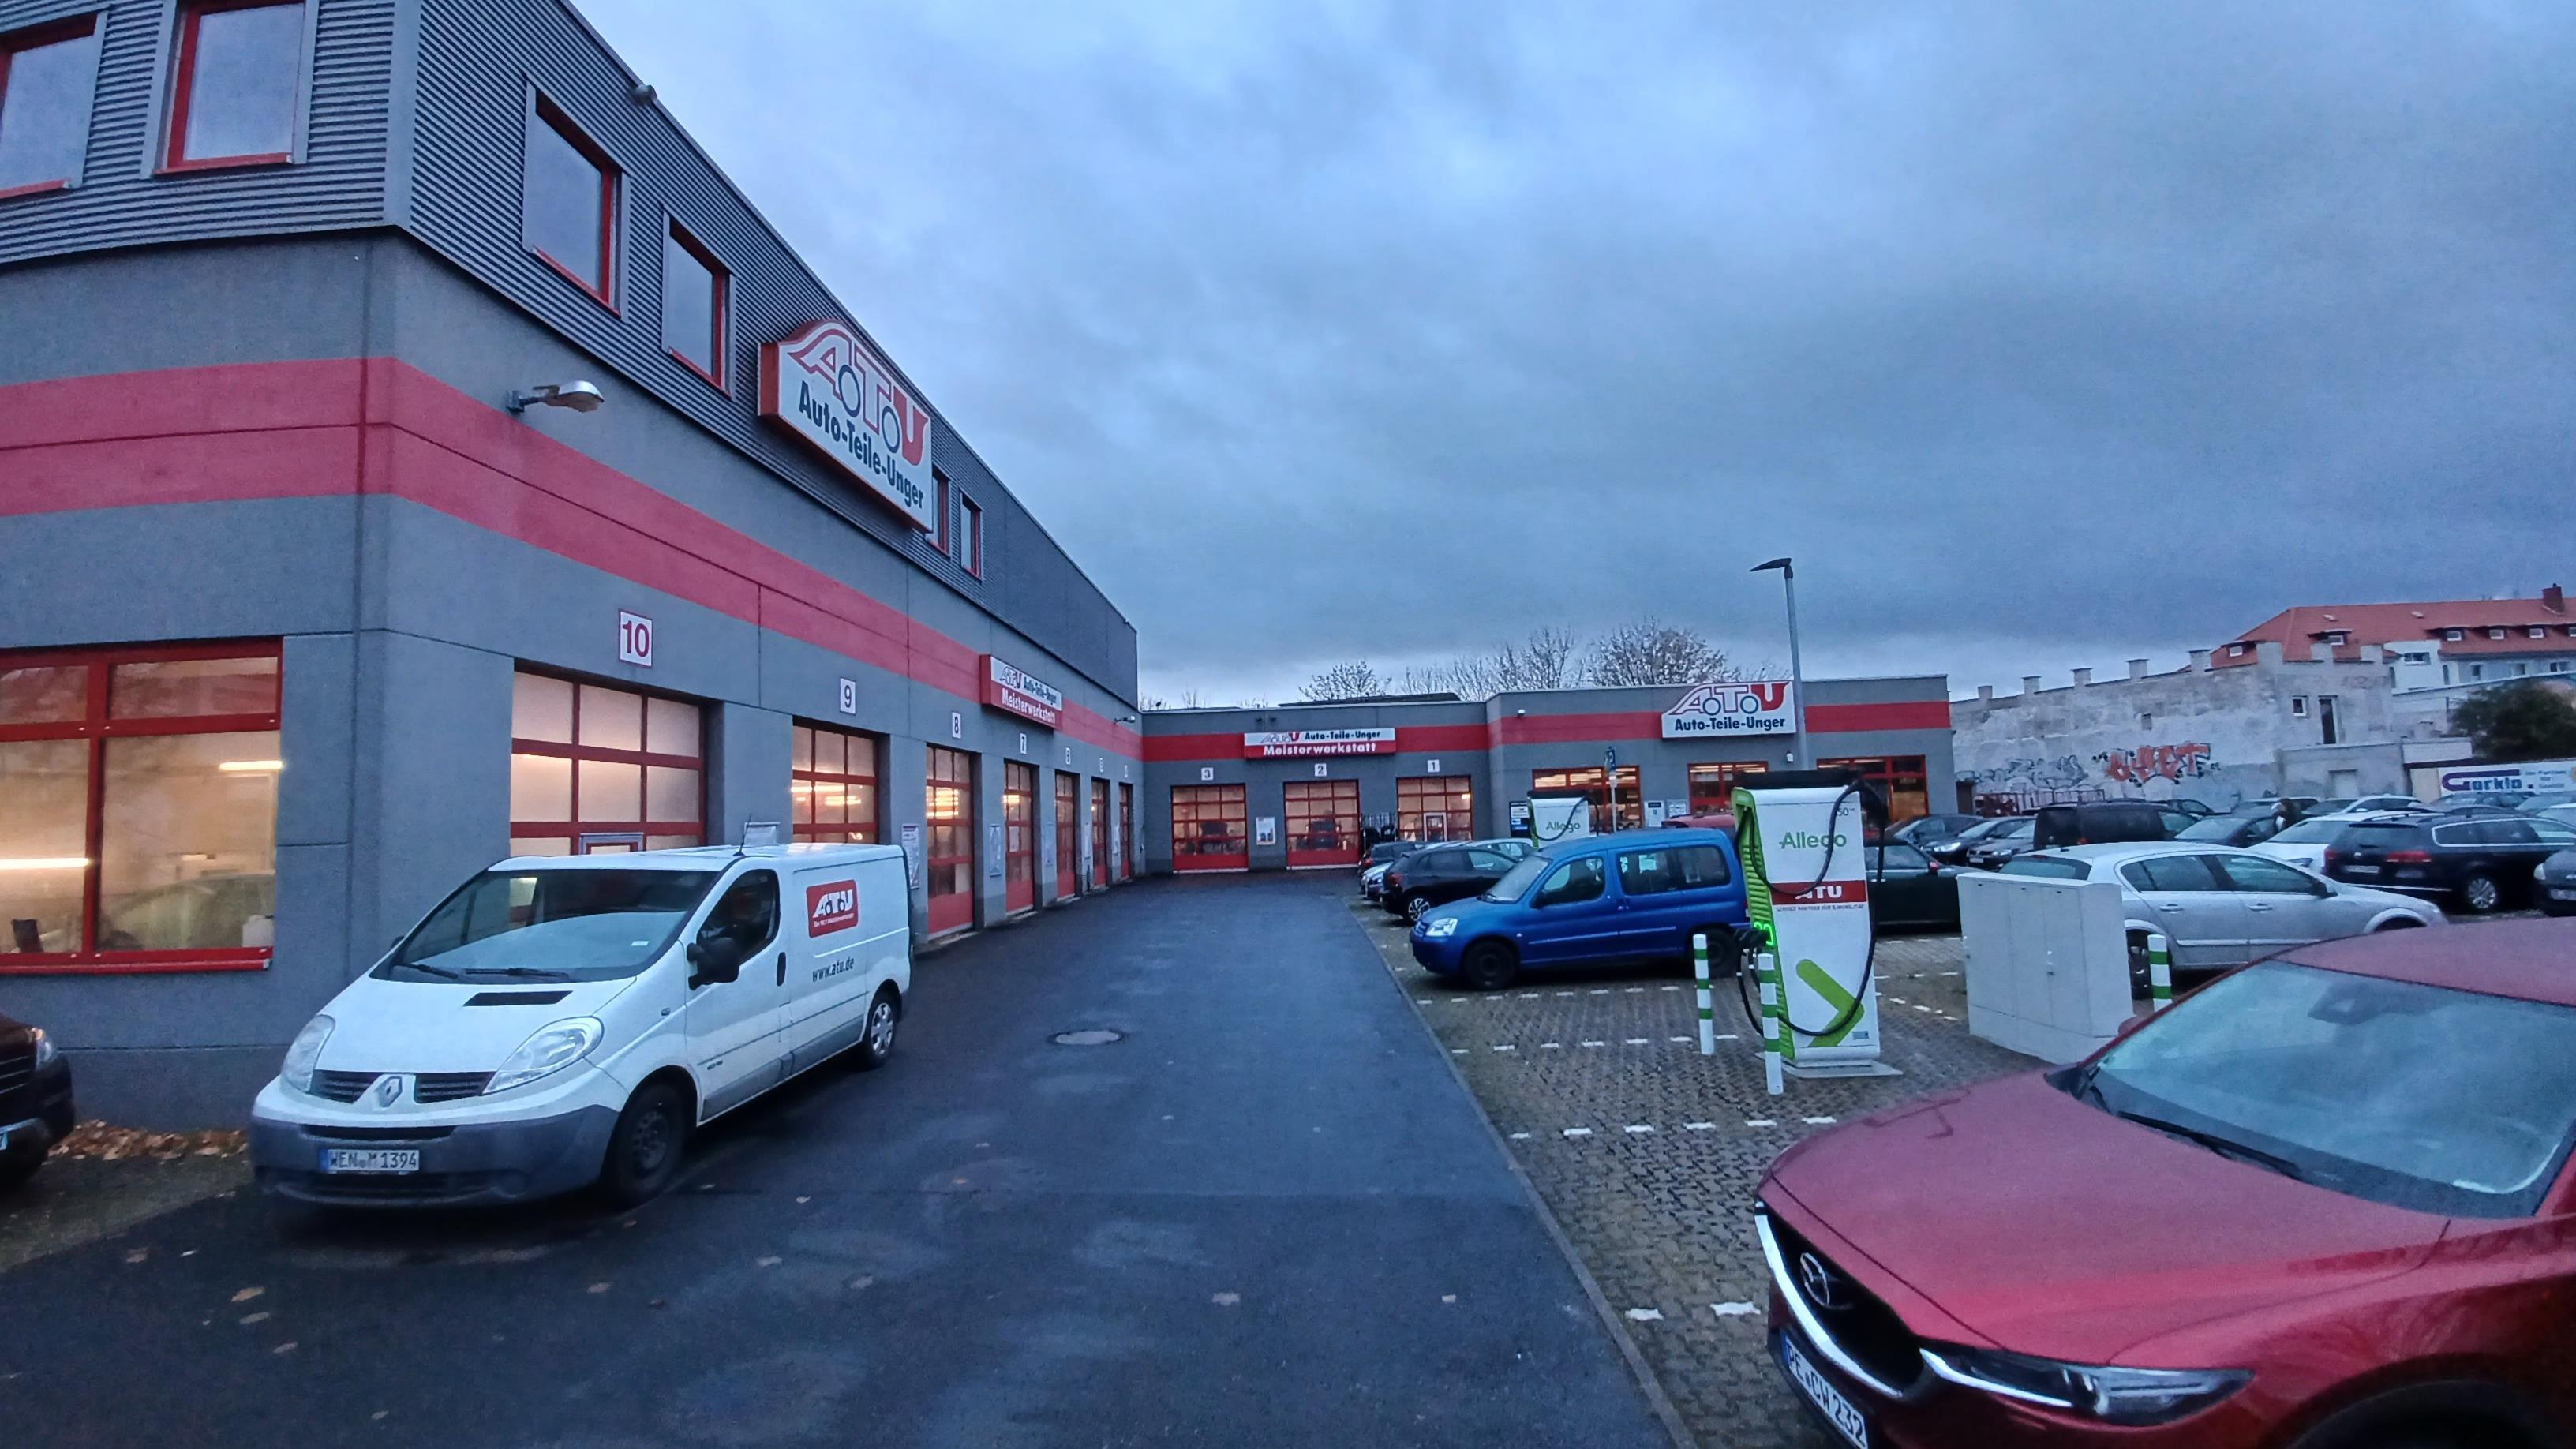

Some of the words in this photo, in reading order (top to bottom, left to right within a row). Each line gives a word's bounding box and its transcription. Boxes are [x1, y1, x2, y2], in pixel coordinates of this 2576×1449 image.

[799, 380, 924, 509] Auto-Teile-Unger
[622, 620, 650, 657] 10
[844, 685, 852, 708] 9
[954, 717, 960, 734] 8
[1305, 730, 1381, 740] Auto-Teile-Unger
[1675, 717, 1785, 732] Auto-Teile-Unger
[1263, 743, 1376, 756] Meisterwerkstatt
[813, 889, 853, 918] ATU
[812, 956, 854, 982] www.atu.de
[380, 1152, 417, 1168] 1394
[1833, 1394, 1866, 1447] 232
